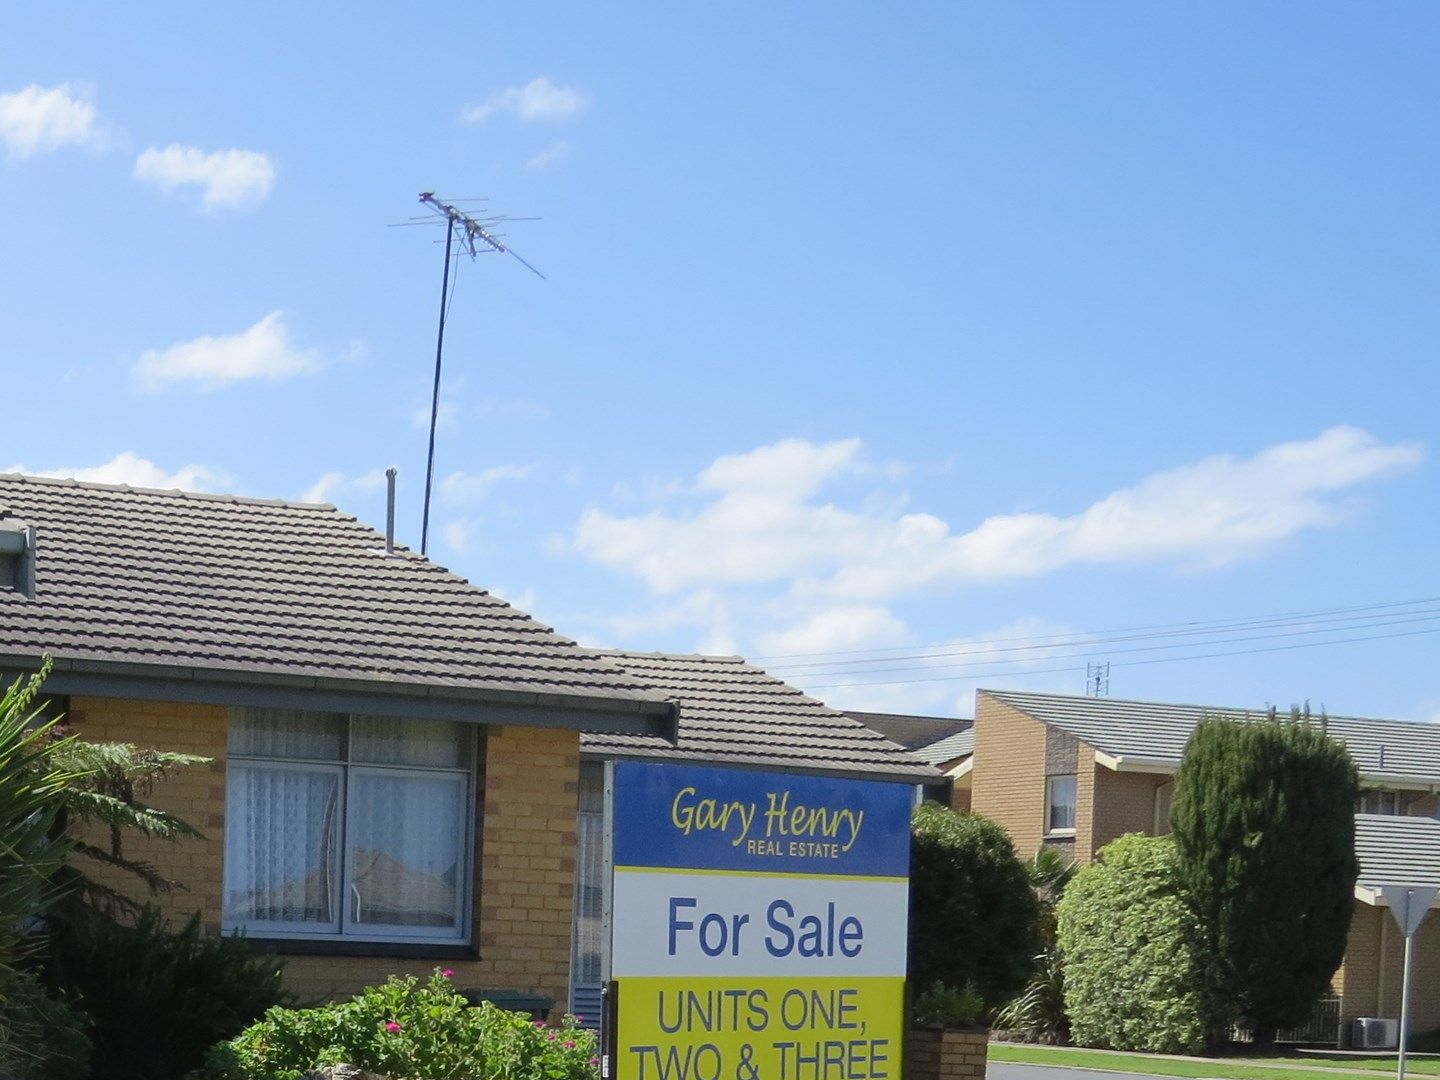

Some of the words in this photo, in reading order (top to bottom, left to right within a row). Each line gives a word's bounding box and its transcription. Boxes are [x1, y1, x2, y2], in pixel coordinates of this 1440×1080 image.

[672, 786, 756, 847] Gary
[765, 790, 863, 852] Henry
[747, 840, 783, 856] REAL
[790, 842, 838, 858] ESTATE
[668, 897, 749, 956] For
[765, 899, 863, 958] Sale
[659, 989, 769, 1033] UNITS
[780, 989, 866, 1035] ONE,
